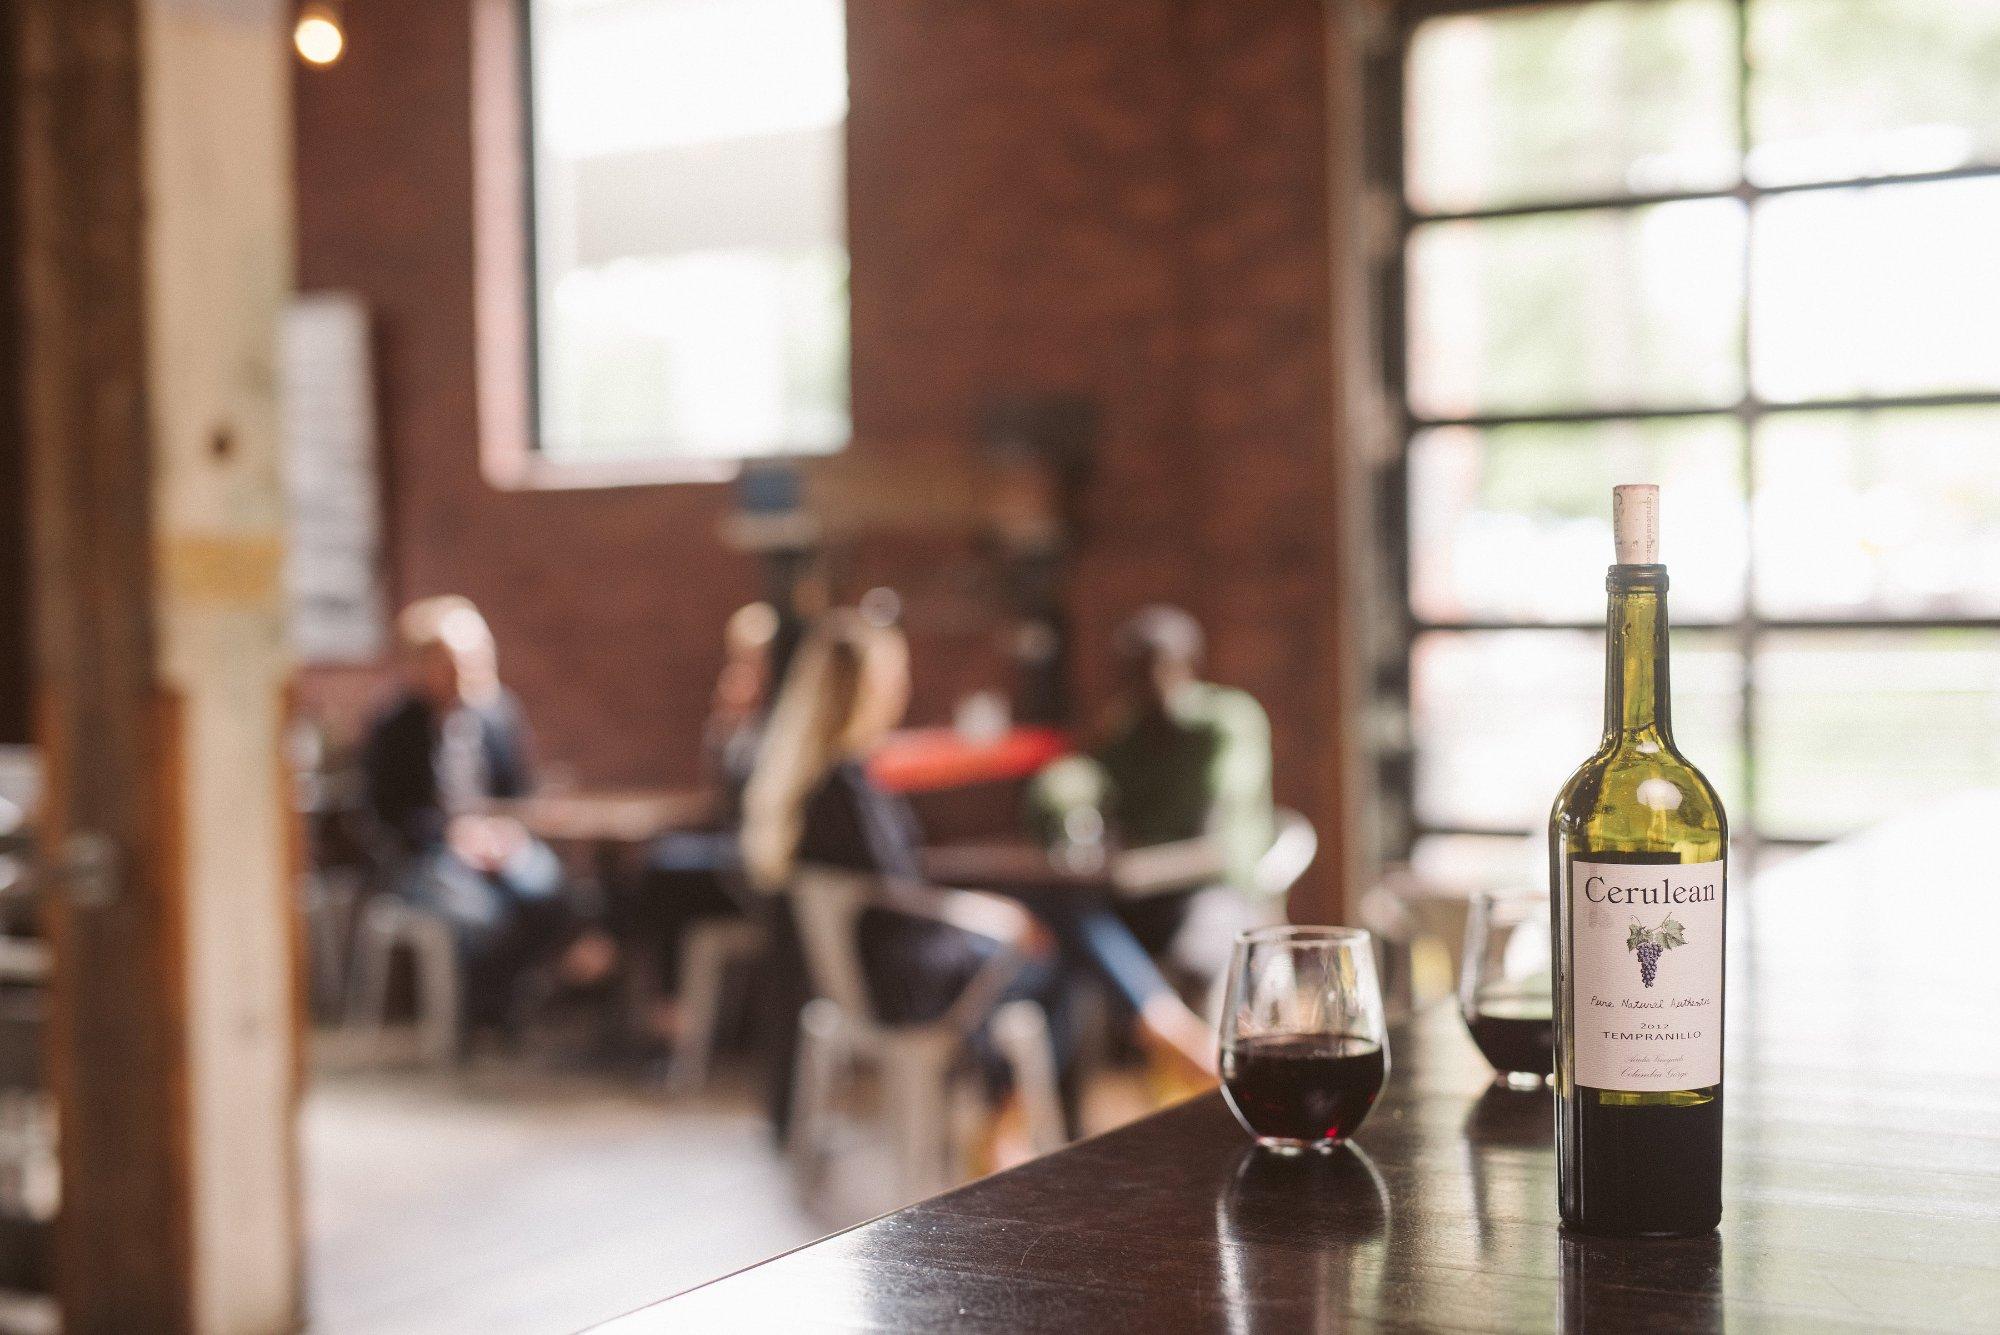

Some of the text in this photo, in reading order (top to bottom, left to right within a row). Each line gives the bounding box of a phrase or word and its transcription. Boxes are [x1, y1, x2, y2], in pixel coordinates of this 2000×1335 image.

[1585, 876, 1715, 904] Cerulean
[1590, 995, 1614, 1008] Pure
[1621, 998, 1663, 1009] Natural
[1601, 1031, 1702, 1041] TEMPRANILLO
[1620, 1067, 1662, 1078] Columbia
